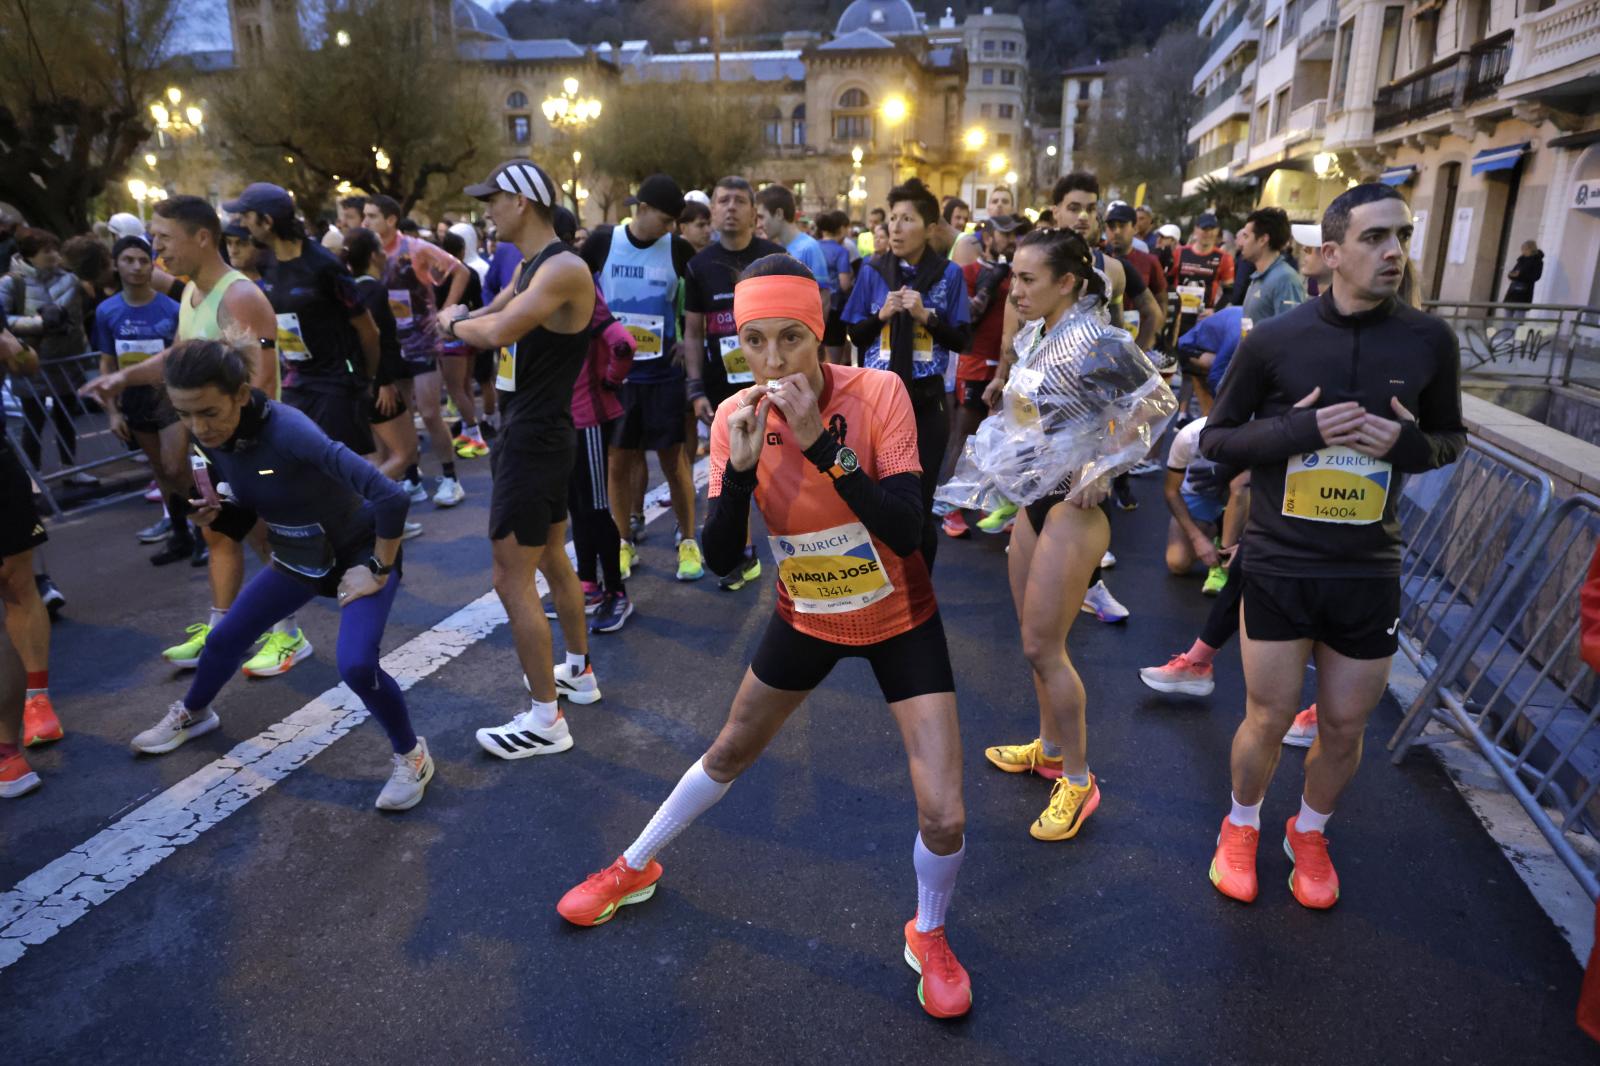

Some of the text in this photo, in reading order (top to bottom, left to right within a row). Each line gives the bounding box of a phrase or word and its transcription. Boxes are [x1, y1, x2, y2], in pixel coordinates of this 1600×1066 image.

[1325, 455, 1376, 466] ZURICH
[1320, 487, 1365, 501] UNAI
[1314, 505, 1358, 518] 14004
[799, 534, 849, 552] ZURICH
[791, 571, 839, 583] MARIA
[838, 560, 880, 580] JOSE
[816, 585, 853, 598] 13414
